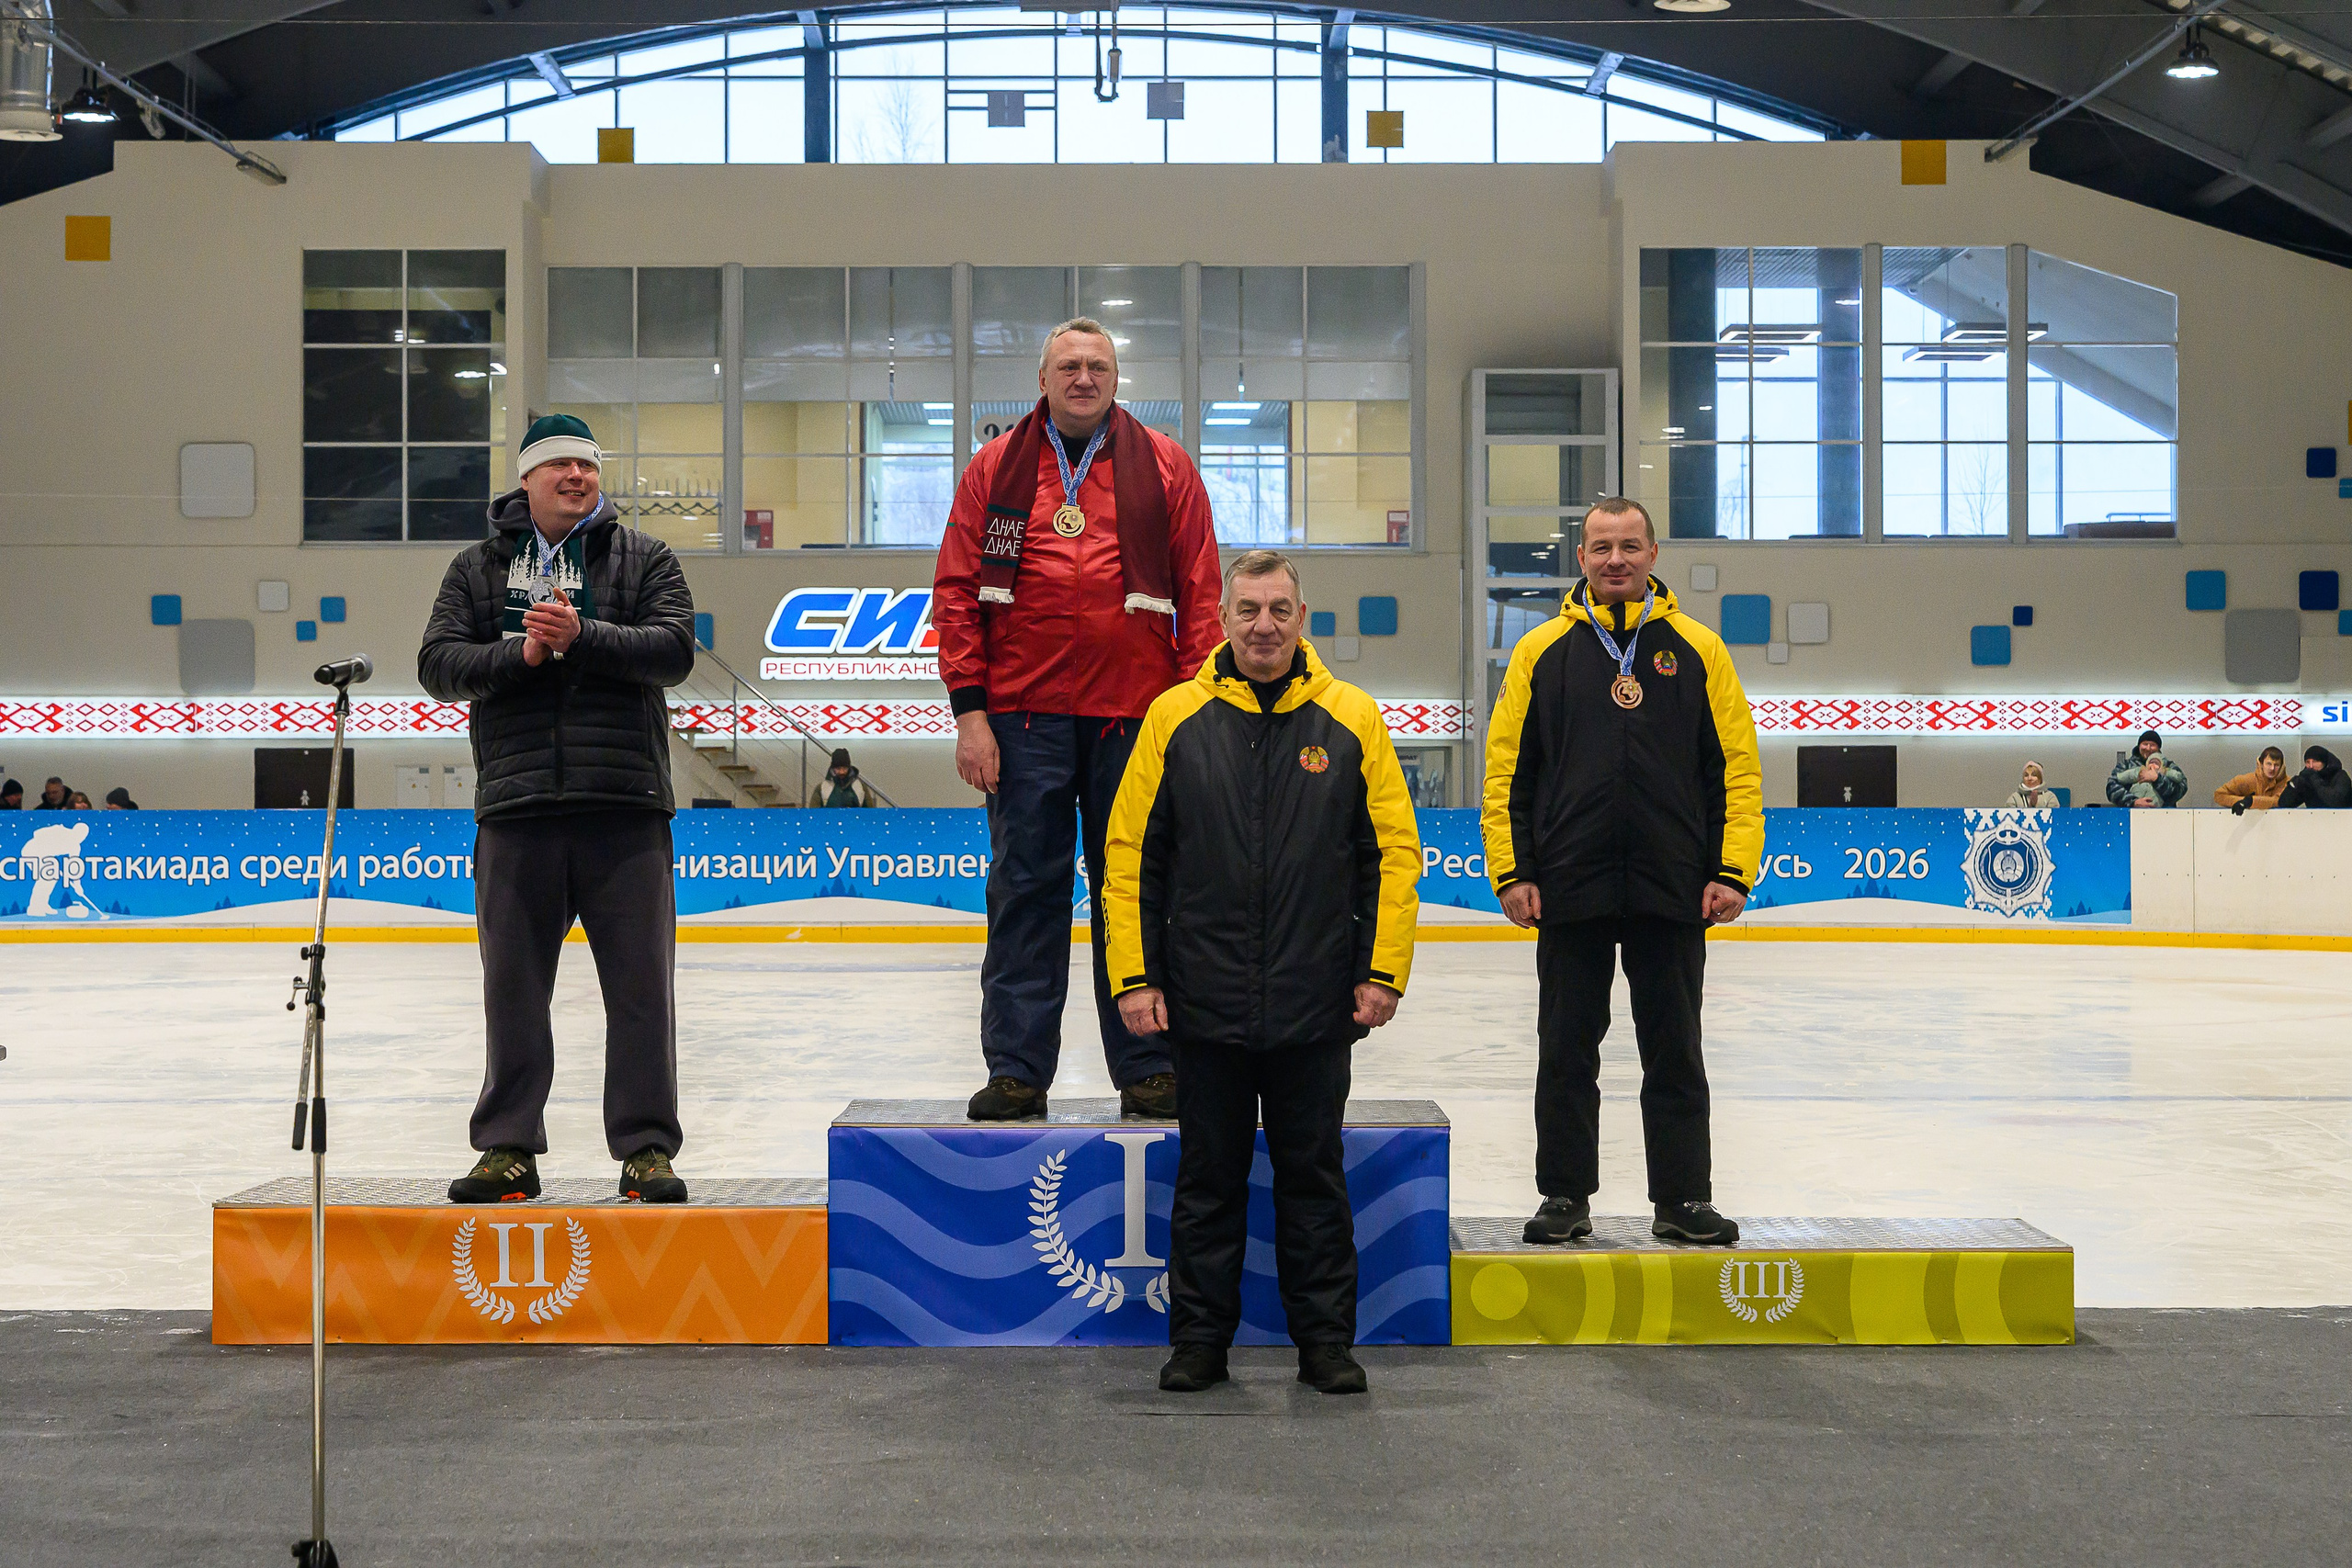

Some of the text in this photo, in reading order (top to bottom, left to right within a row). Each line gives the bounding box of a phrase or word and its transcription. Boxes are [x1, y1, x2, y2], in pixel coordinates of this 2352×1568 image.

[767, 590, 940, 650] СИ
[0, 854, 230, 888] спартакиада
[239, 854, 347, 887] среди
[1421, 846, 1489, 878] Рес
[1843, 847, 1929, 879] 2026
[1104, 1133, 1166, 1268] I
[488, 1223, 554, 1288] II
[1733, 1261, 1791, 1299] III
